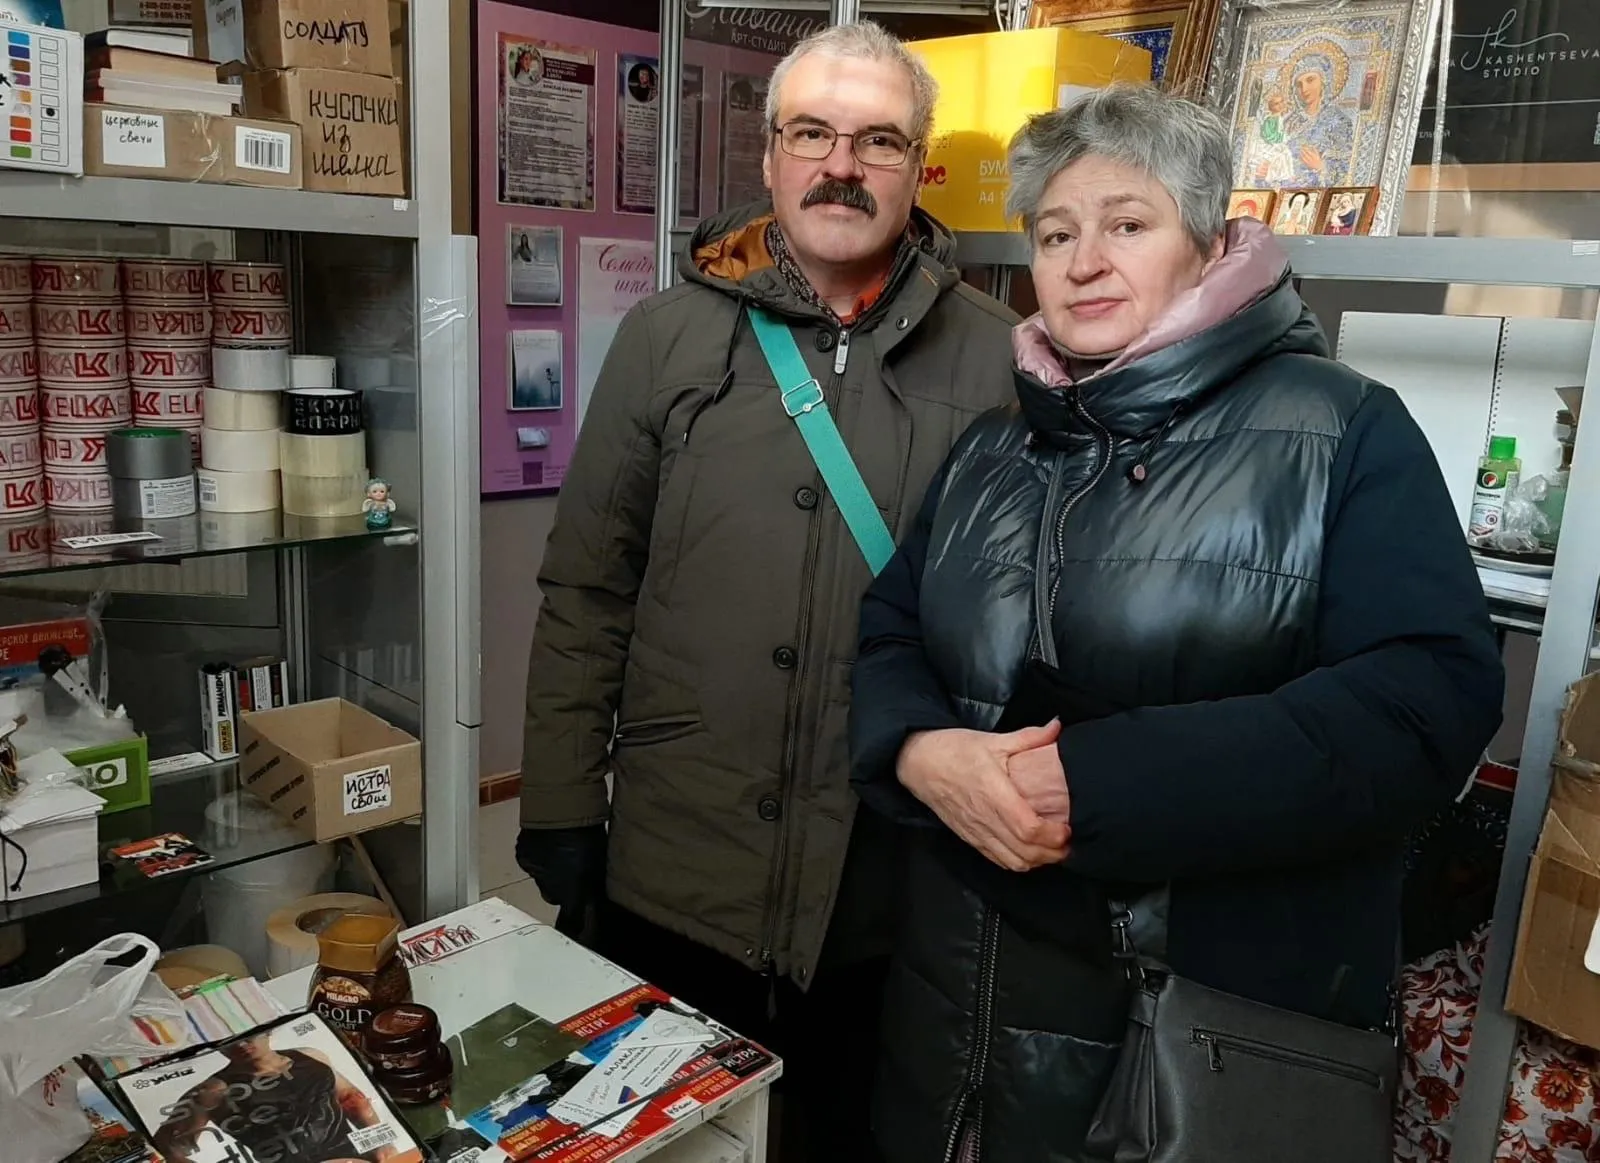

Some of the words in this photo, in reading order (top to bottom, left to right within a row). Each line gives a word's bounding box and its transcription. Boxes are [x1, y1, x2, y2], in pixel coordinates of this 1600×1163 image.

[1485, 49, 1600, 65] KASHENTSEVA
[1483, 66, 1540, 78] STUDIO
[105, 114, 159, 129] церковные
[119, 130, 152, 144] свечи
[979, 160, 1010, 176] БУМ
[346, 769, 391, 795] ИСТРА
[317, 1002, 372, 1024] GOLD
[723, 1048, 758, 1067] ИСТРА
